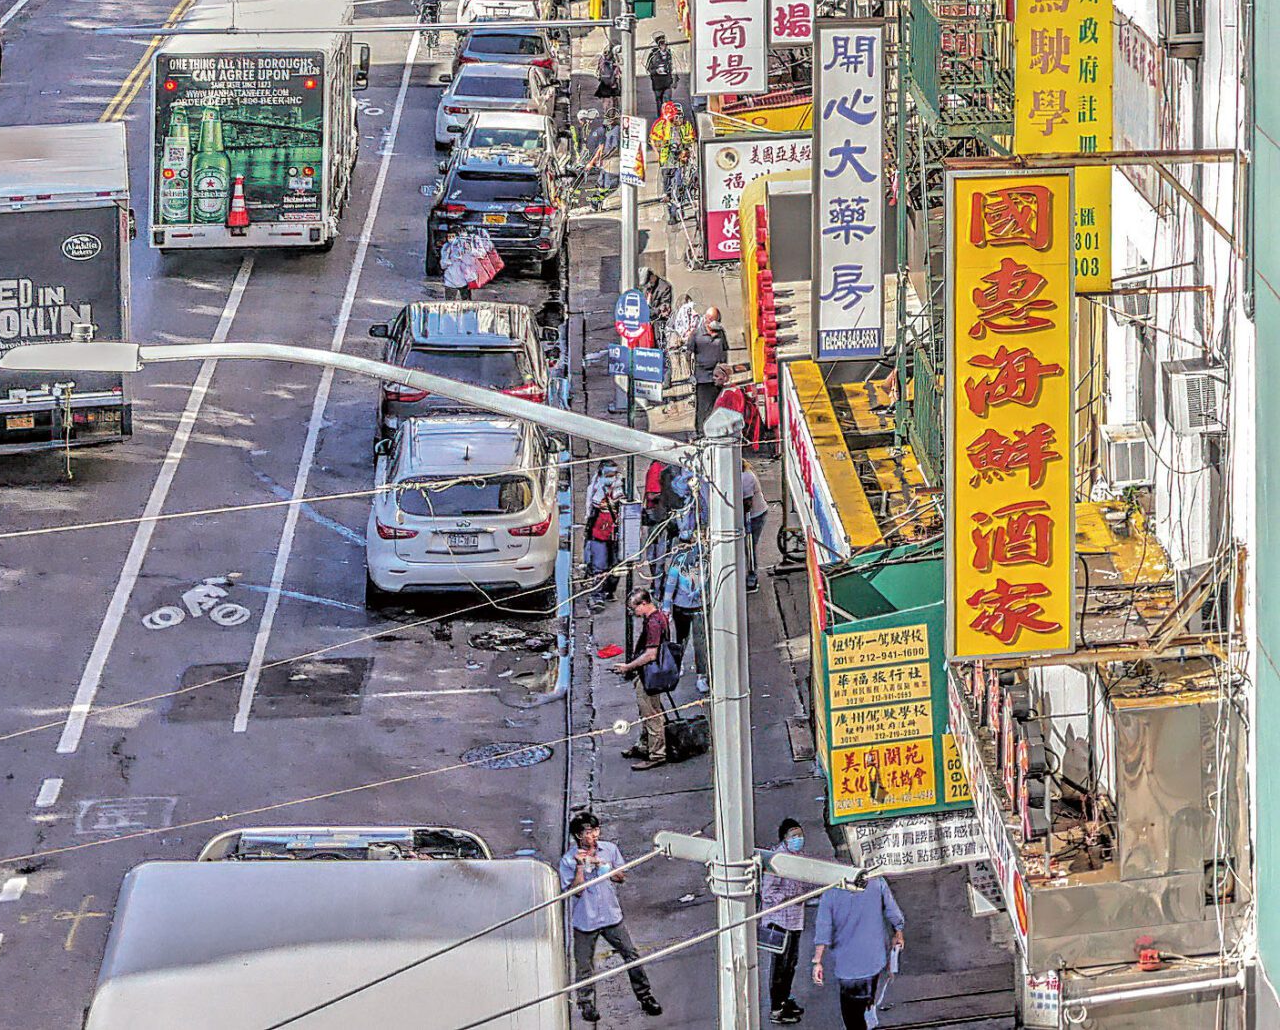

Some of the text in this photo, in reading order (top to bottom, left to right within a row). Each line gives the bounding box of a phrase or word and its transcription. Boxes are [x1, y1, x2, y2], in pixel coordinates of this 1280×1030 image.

[170, 58, 187, 70] ONE
[189, 58, 216, 70] THING
[218, 58, 235, 69] ALL
[258, 58, 313, 70] BOROUGHS
[192, 69, 290, 81] CAN AGREE UPON
[820, 35, 877, 311] 開心大藥房
[38, 286, 65, 306] IN
[966, 184, 1063, 646] 國惠海鮮酒家
